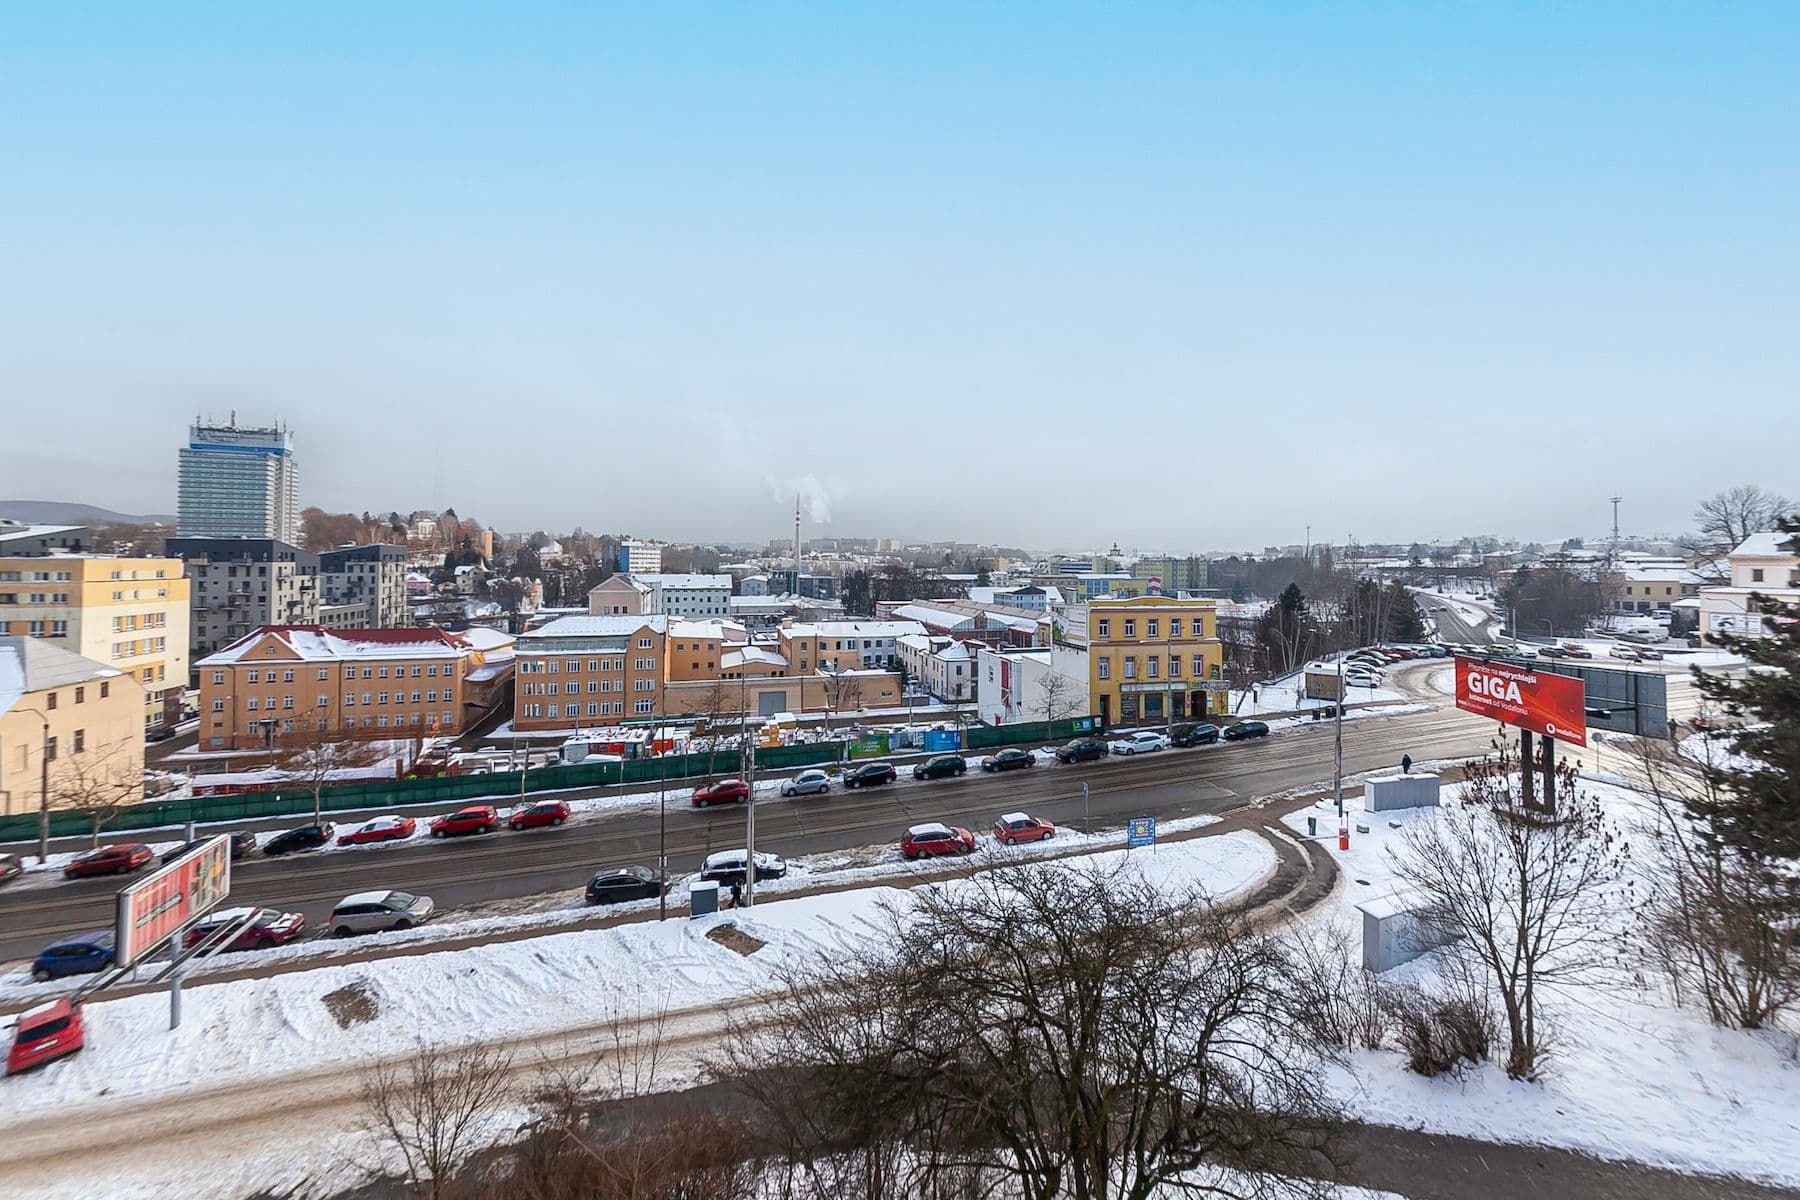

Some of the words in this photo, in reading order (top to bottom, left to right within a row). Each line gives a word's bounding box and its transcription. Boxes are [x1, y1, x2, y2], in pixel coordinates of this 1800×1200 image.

[1467, 671, 1523, 705] GIGA
[1468, 692, 1492, 705] Internet
[1556, 728, 1582, 740] vodafone
